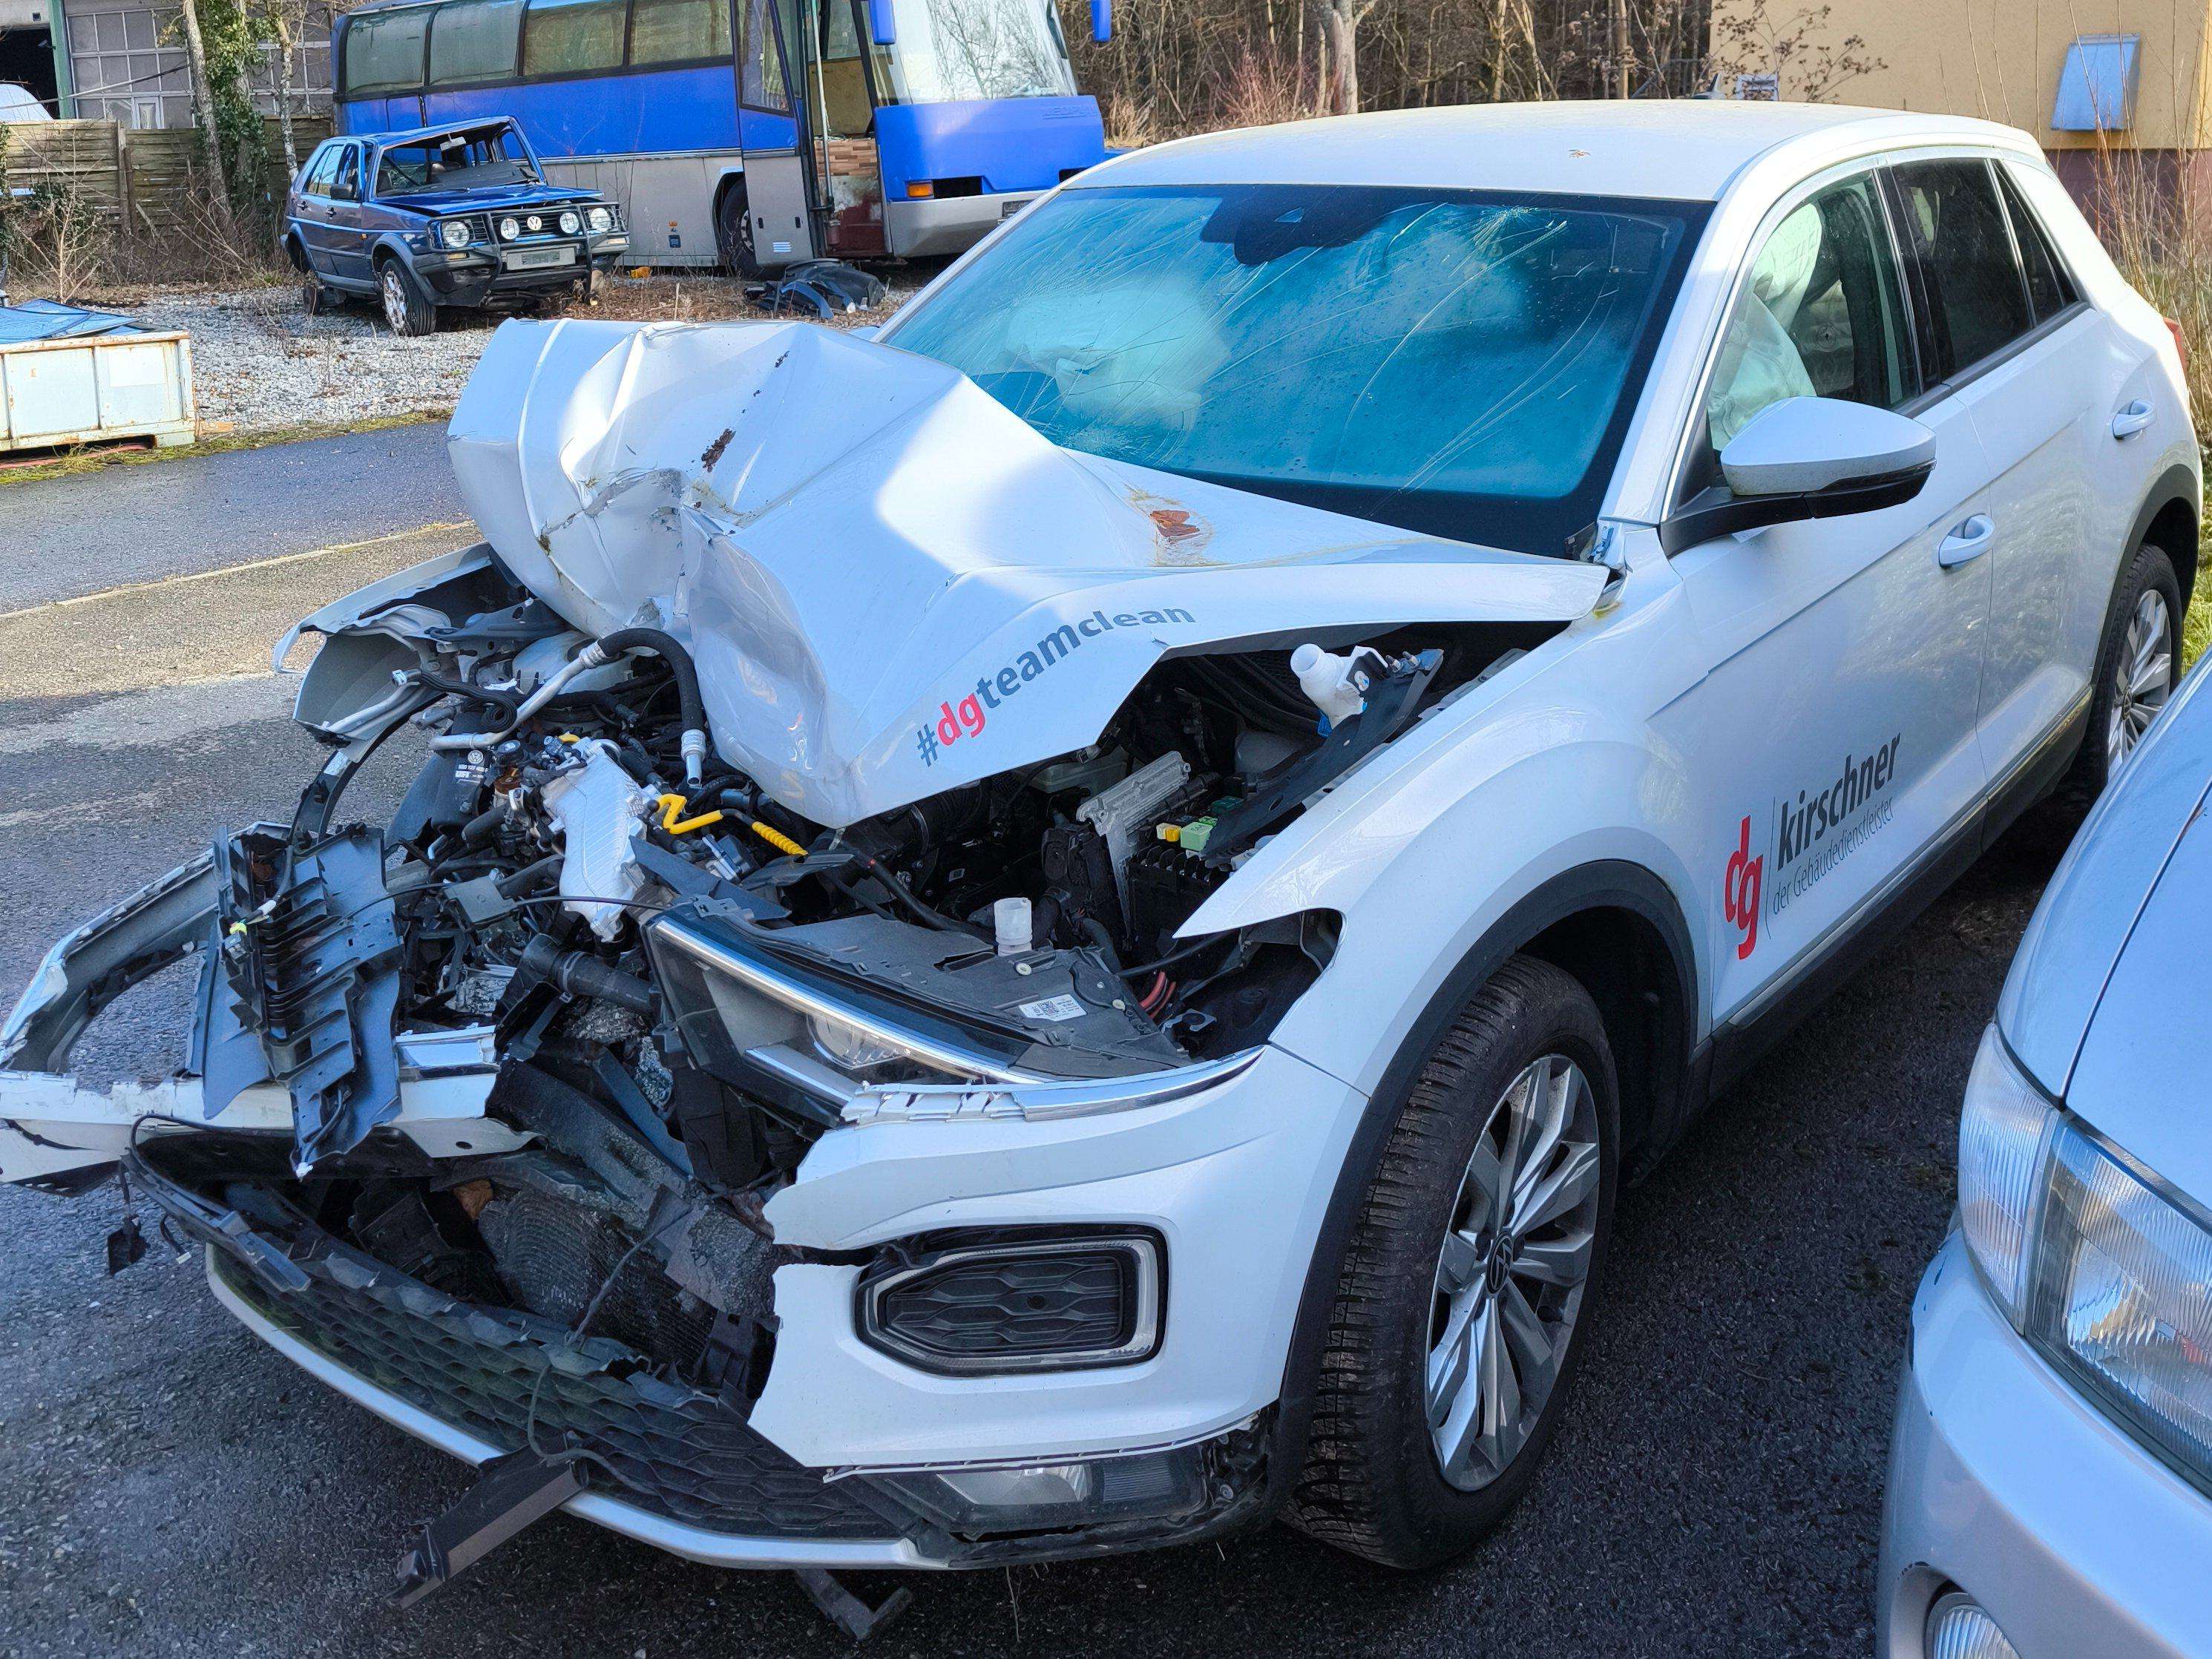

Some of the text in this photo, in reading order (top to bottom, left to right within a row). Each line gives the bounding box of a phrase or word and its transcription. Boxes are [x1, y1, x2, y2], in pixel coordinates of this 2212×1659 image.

[916, 607, 1196, 768] #dgteamclean
[1773, 796, 1894, 915] der Gebäudedienstleister
[1777, 732, 1901, 872] kirschner
[1724, 815, 1764, 960] dg
